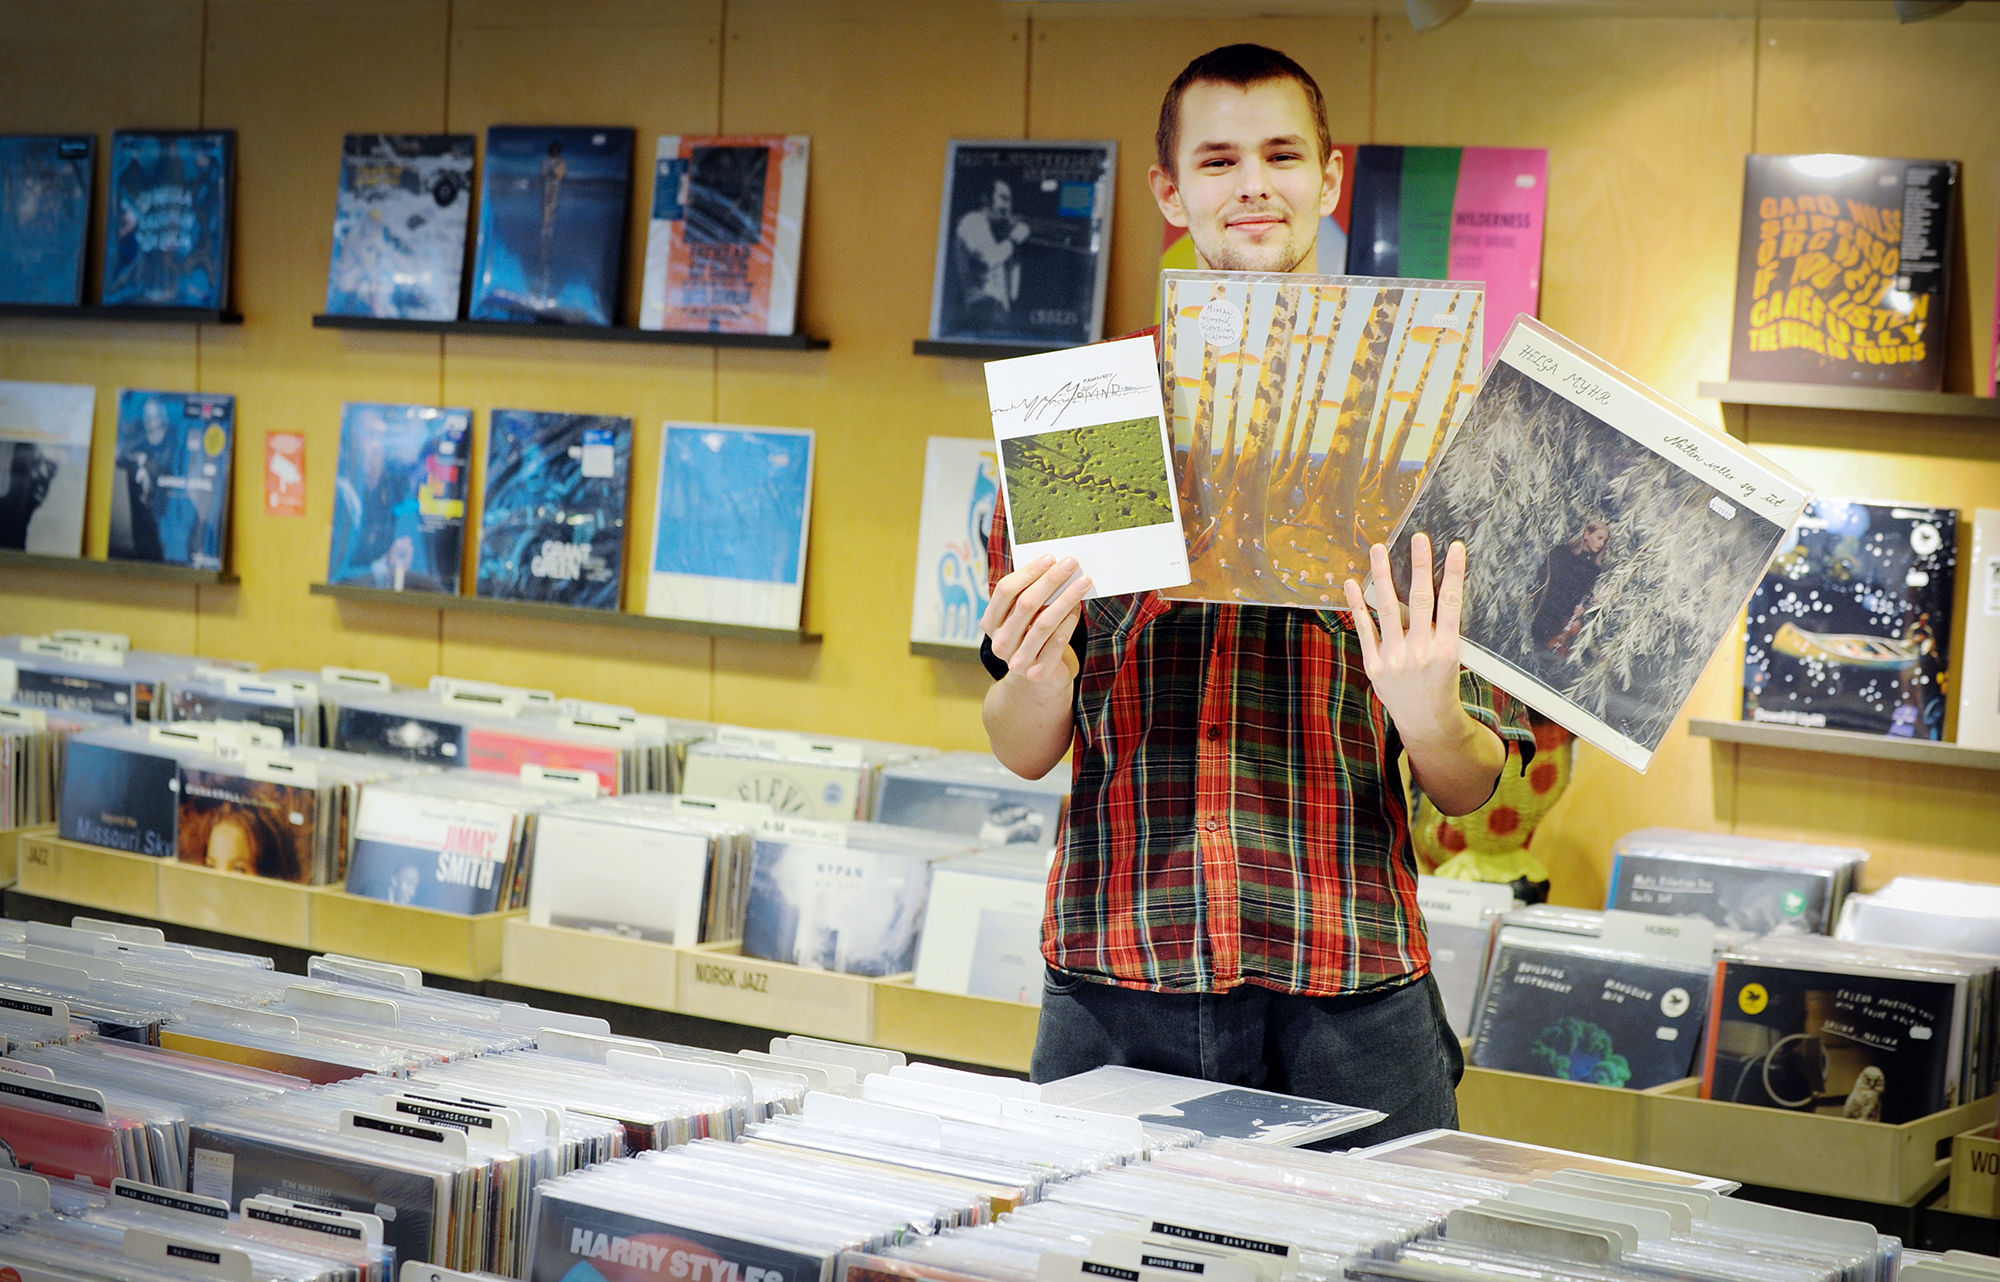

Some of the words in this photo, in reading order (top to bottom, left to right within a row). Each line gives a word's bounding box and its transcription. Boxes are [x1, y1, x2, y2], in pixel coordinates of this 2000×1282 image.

[1851, 342, 1927, 365] YOURS
[1518, 344, 1559, 376] HELGA
[1563, 373, 1611, 406] MYHR
[443, 824, 498, 859] JIMMY
[435, 852, 496, 890] SMITH
[816, 863, 864, 878] NYPAN
[1644, 924, 1681, 938] HUBRO
[695, 963, 737, 988] NORSK
[739, 970, 769, 994] JAZZ
[407, 1104, 422, 1114] THE
[426, 1108, 484, 1126] REPLACEMENTS
[281, 1178, 297, 1190] TOM
[298, 1183, 332, 1199] MORELLO
[1163, 1225, 1193, 1237] SIMON
[1197, 1232, 1216, 1242] AND
[570, 1227, 670, 1273] HARRY
